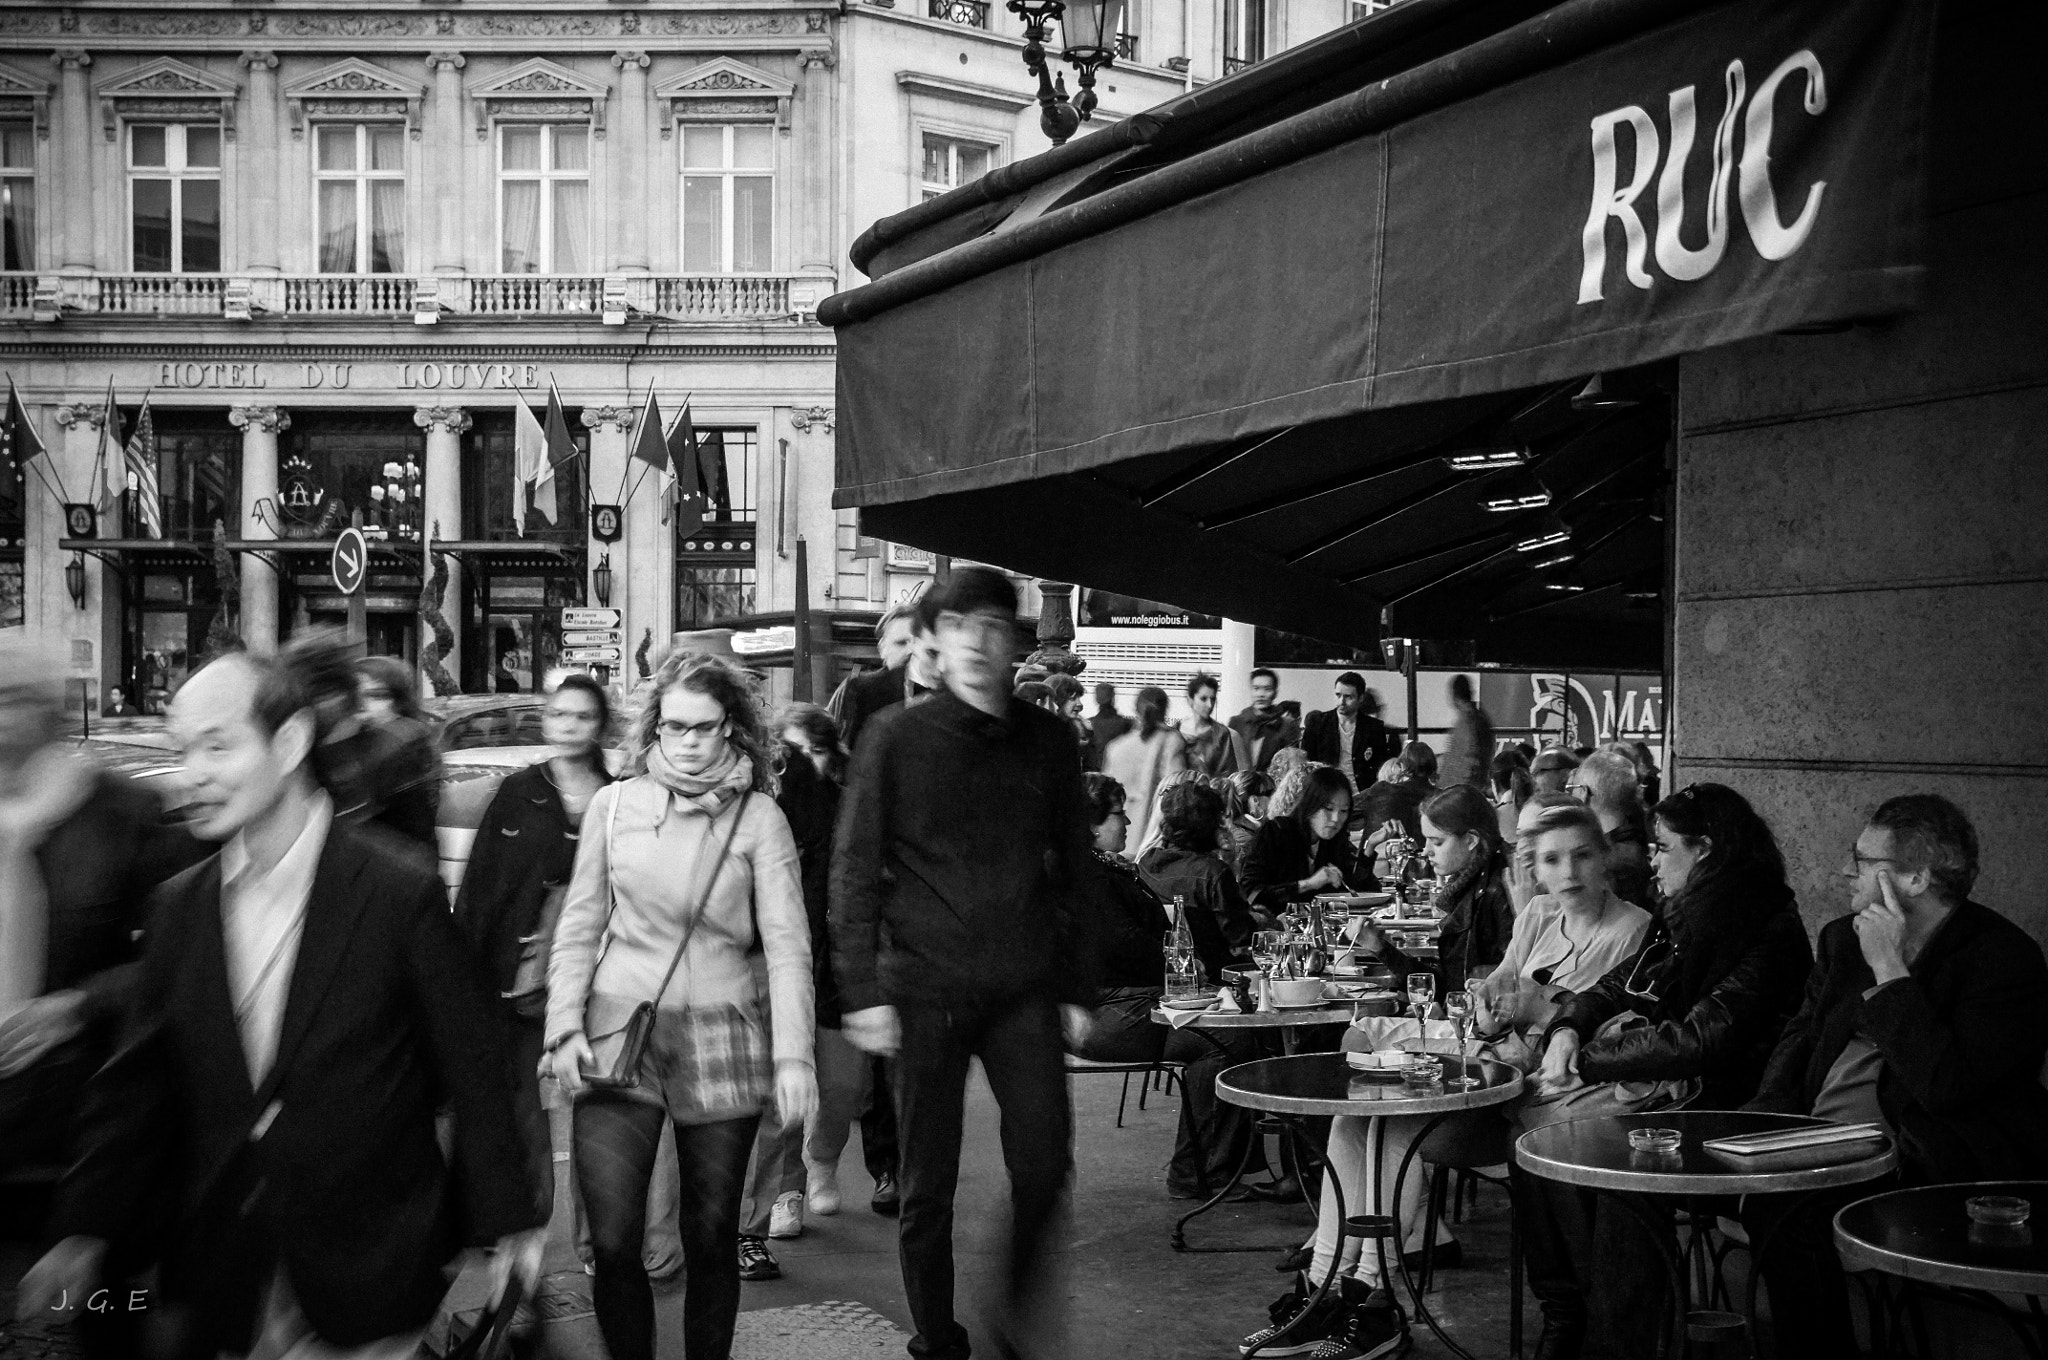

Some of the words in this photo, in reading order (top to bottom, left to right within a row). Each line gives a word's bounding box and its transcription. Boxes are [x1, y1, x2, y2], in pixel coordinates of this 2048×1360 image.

[1577, 49, 1828, 305] RUC
[154, 363, 267, 389] HOTEL
[300, 363, 352, 389] DU
[396, 363, 540, 389] LOUVRE
[1111, 615, 1189, 627] www.noleggiobus.it
[1600, 690, 1662, 739] MA
